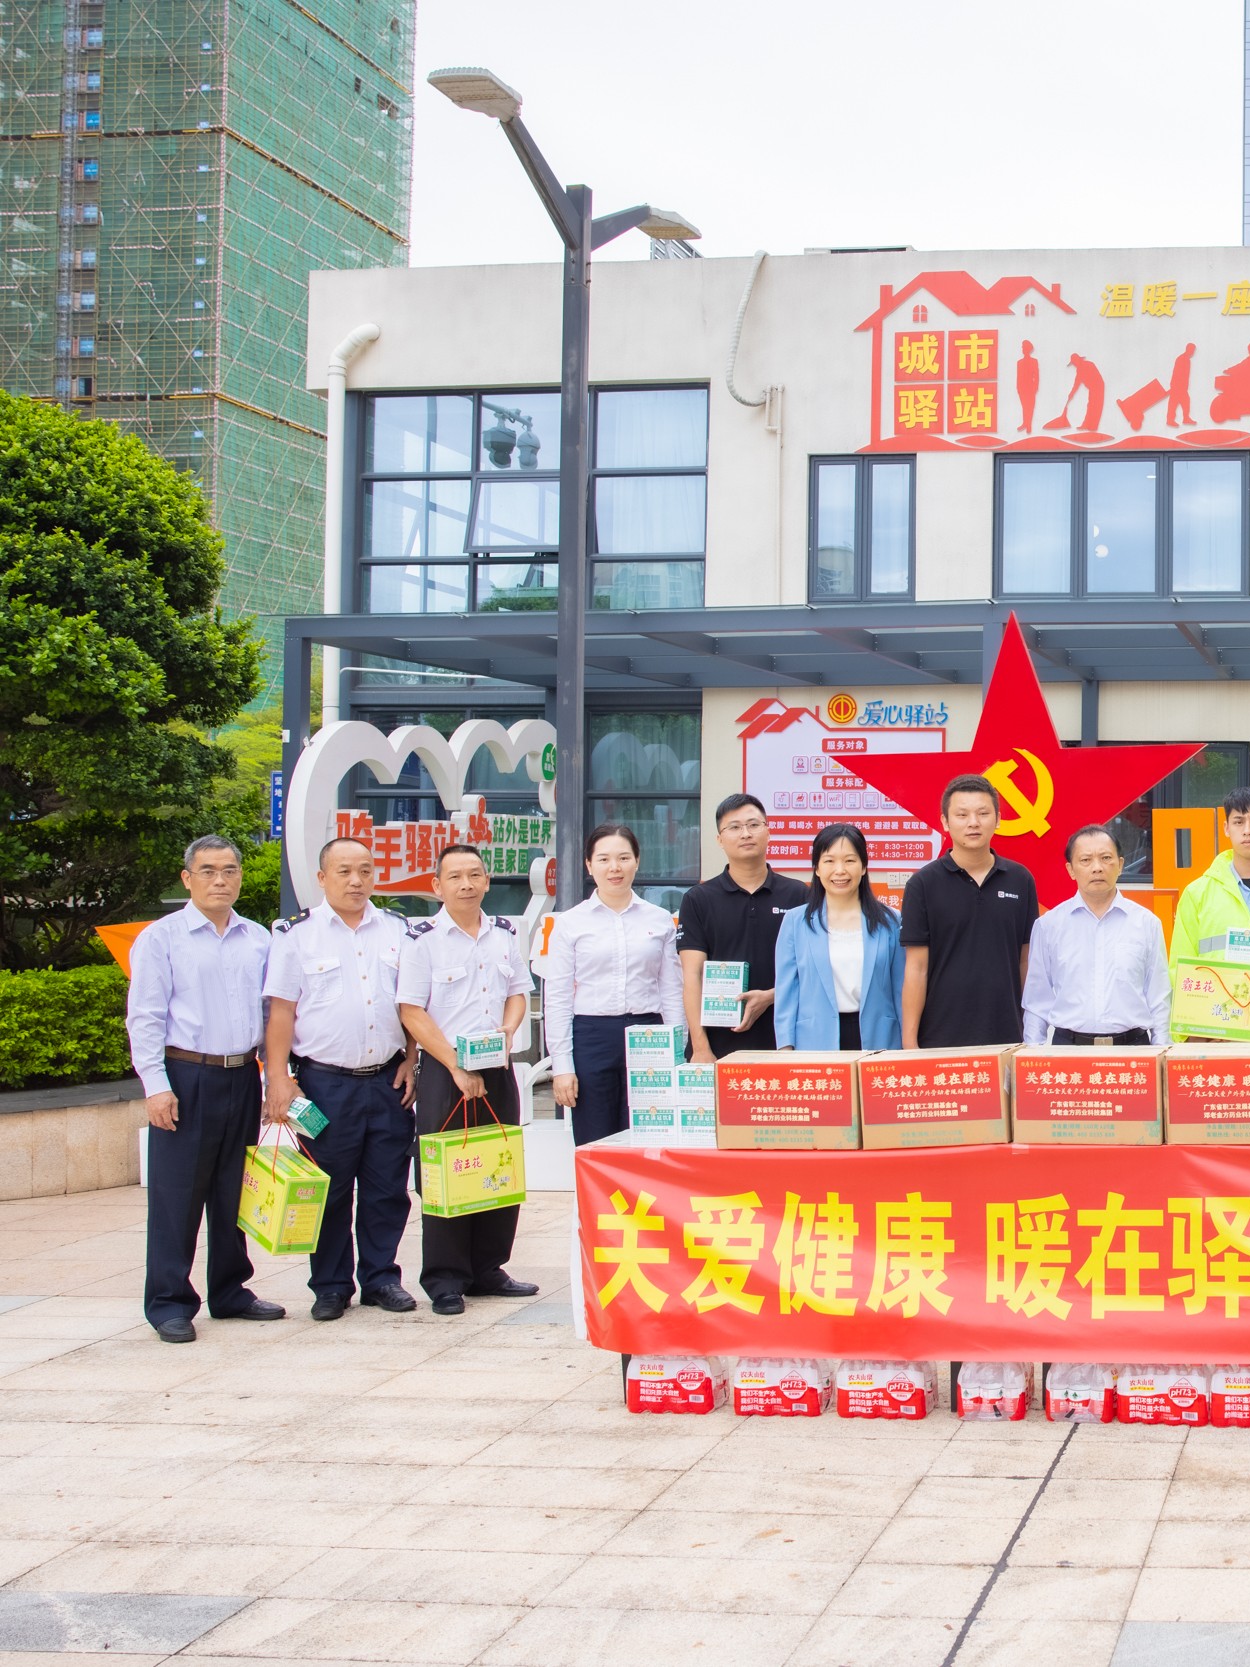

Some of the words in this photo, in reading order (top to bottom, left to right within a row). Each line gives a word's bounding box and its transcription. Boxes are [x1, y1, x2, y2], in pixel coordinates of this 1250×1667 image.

[898, 333, 995, 376] 城市
[898, 388, 994, 429] 驿站
[858, 699, 949, 727] 爱心驿站
[826, 740, 865, 751] 服务对象
[825, 777, 864, 788] 服务标配
[492, 816, 551, 847] 站外是世界
[767, 821, 785, 830] 歇脚
[479, 848, 529, 876] 内是家园
[877, 895, 903, 907] 你我
[1181, 977, 1215, 993] 霸王花
[727, 1078, 781, 1091] 关爱健康
[787, 1078, 842, 1091] 暖在驿站
[871, 1073, 927, 1089] 关爱健康
[933, 1071, 990, 1086] 暖在驿站
[1025, 1071, 1082, 1084] 关爱健康
[1088, 1071, 1147, 1084] 暖在驿站
[1178, 1073, 1236, 1087] 关爱健康
[452, 1155, 484, 1173] 霸王花
[594, 1191, 956, 1319] 关爱健康
